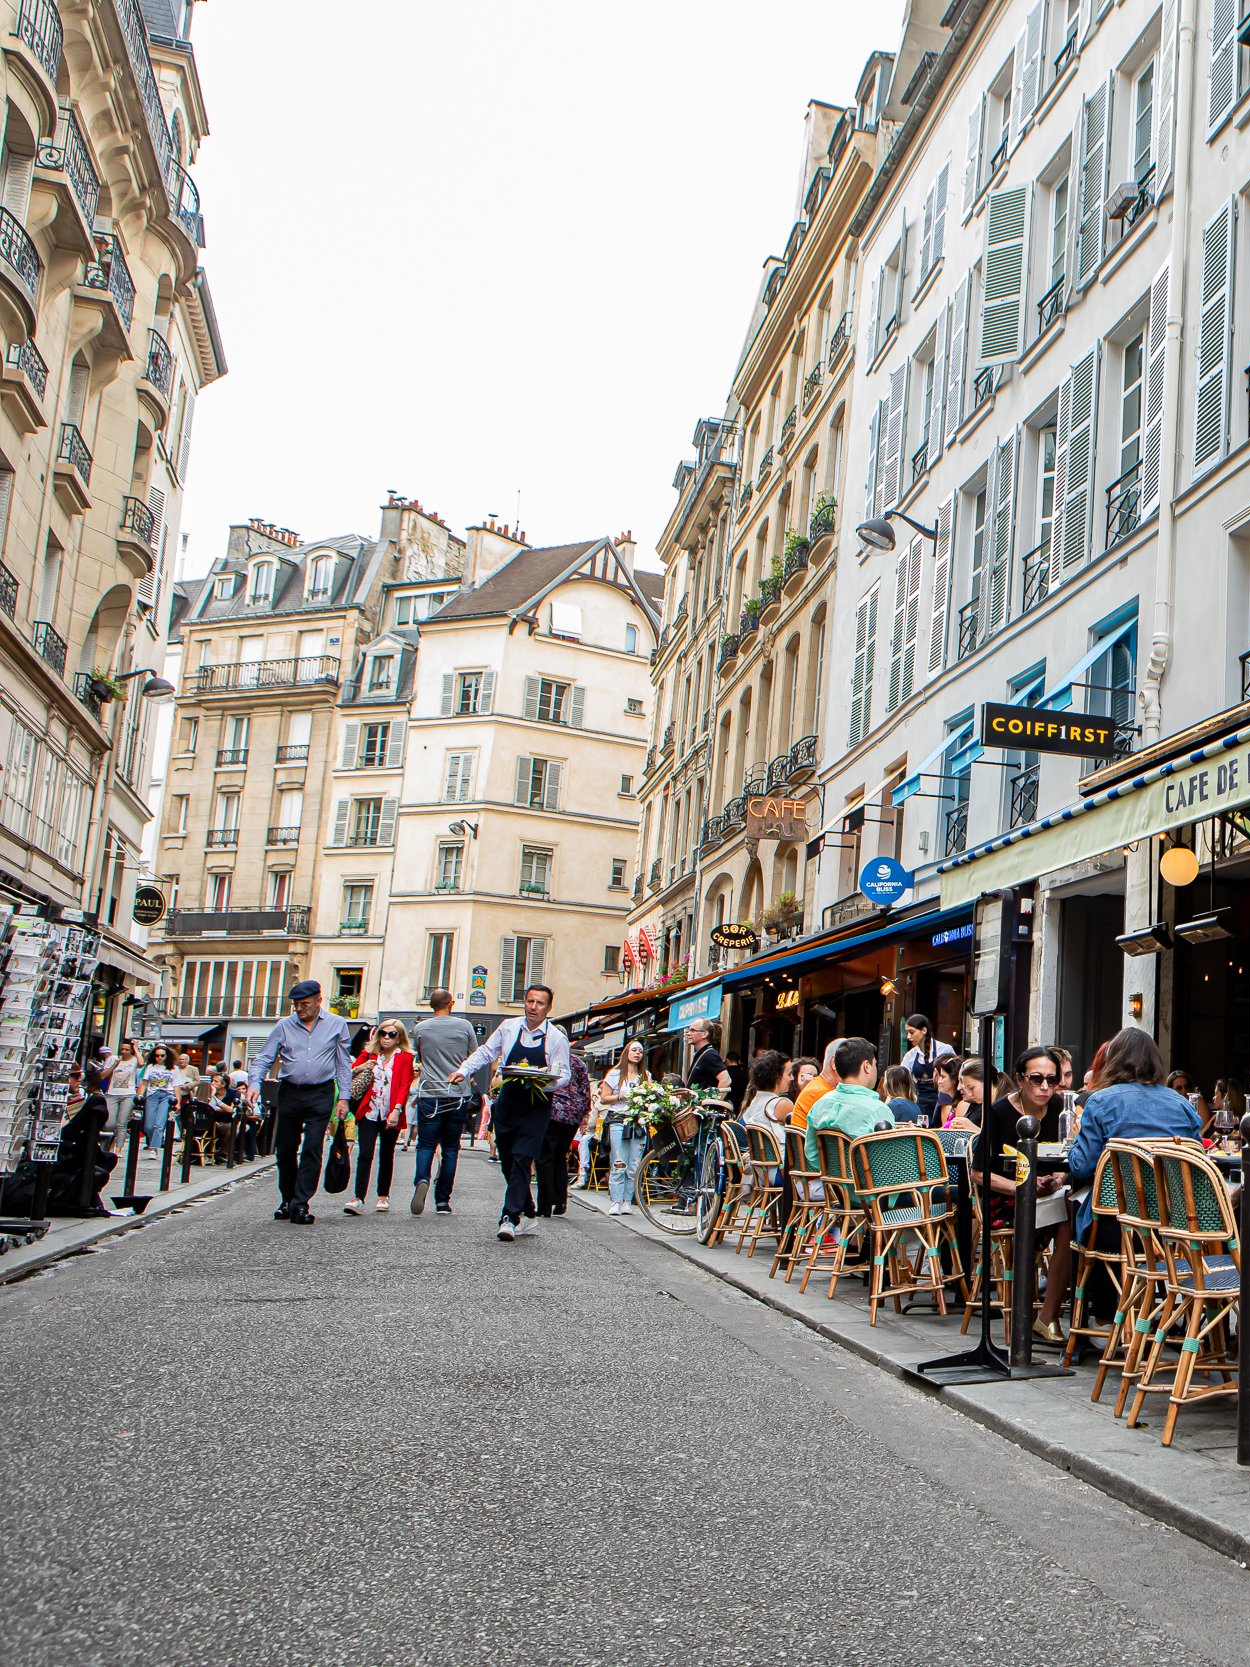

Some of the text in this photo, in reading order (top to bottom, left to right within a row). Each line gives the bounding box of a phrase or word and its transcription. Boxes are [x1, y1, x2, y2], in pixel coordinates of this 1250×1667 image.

[992, 717, 1109, 744] COIFF1RST
[1165, 770, 1209, 813] CAFE
[1216, 758, 1238, 796] DE
[749, 799, 805, 819] CAFE
[135, 898, 162, 907] PAUL
[712, 932, 755, 948] CREPERIE
